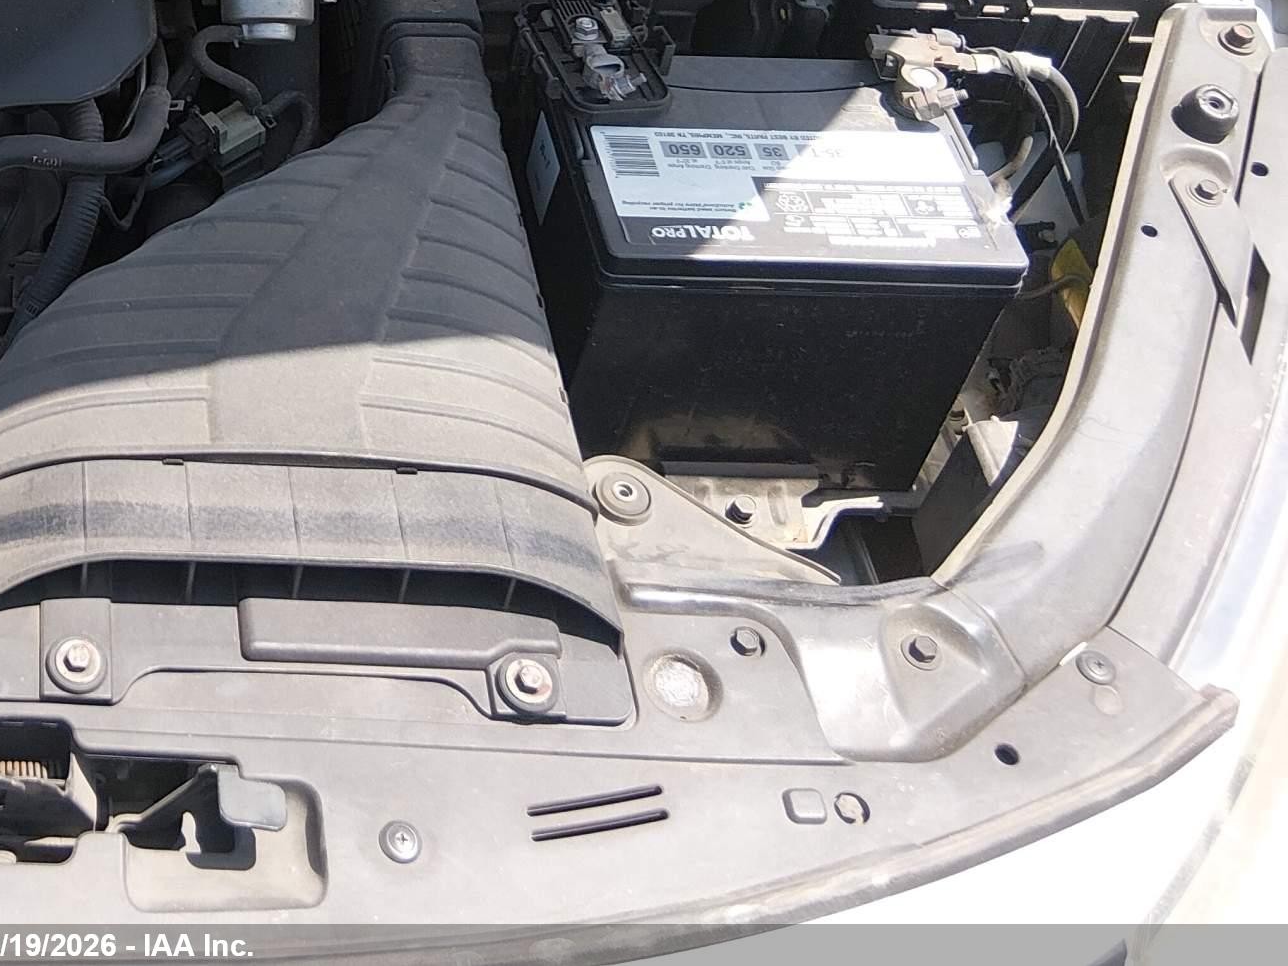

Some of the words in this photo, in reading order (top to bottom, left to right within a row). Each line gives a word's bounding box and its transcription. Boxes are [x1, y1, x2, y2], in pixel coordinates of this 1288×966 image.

[668, 144, 700, 155] 650
[713, 145, 745, 156] 520
[762, 147, 782, 157] 35
[651, 224, 755, 241] TOTALPRO
